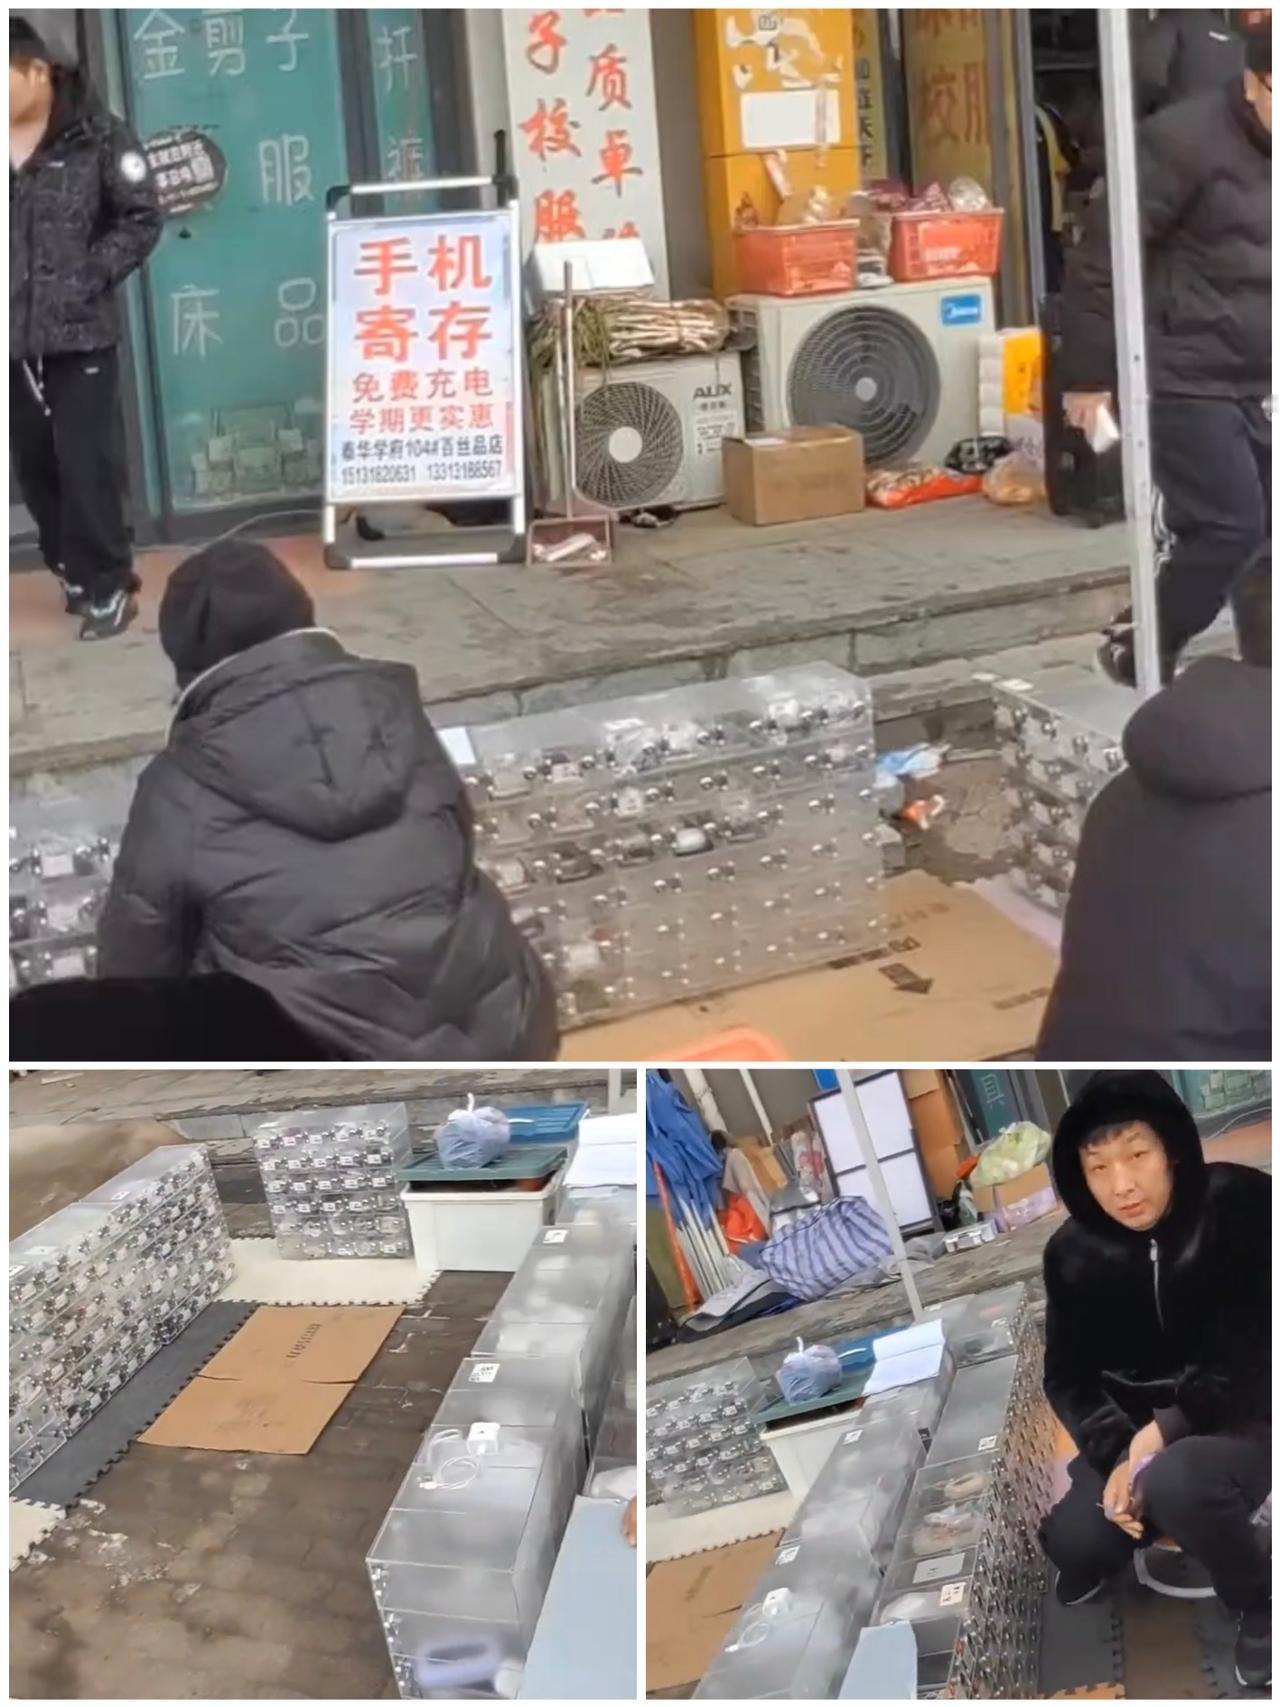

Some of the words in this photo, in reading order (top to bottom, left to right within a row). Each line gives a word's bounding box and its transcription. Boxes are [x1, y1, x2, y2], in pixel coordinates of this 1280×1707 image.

[354, 235, 492, 295] 手机
[354, 301, 492, 362] 寄存
[352, 366, 493, 403] 免费充电
[693, 382, 732, 400] AUX
[350, 403, 493, 435] 学期更实惠
